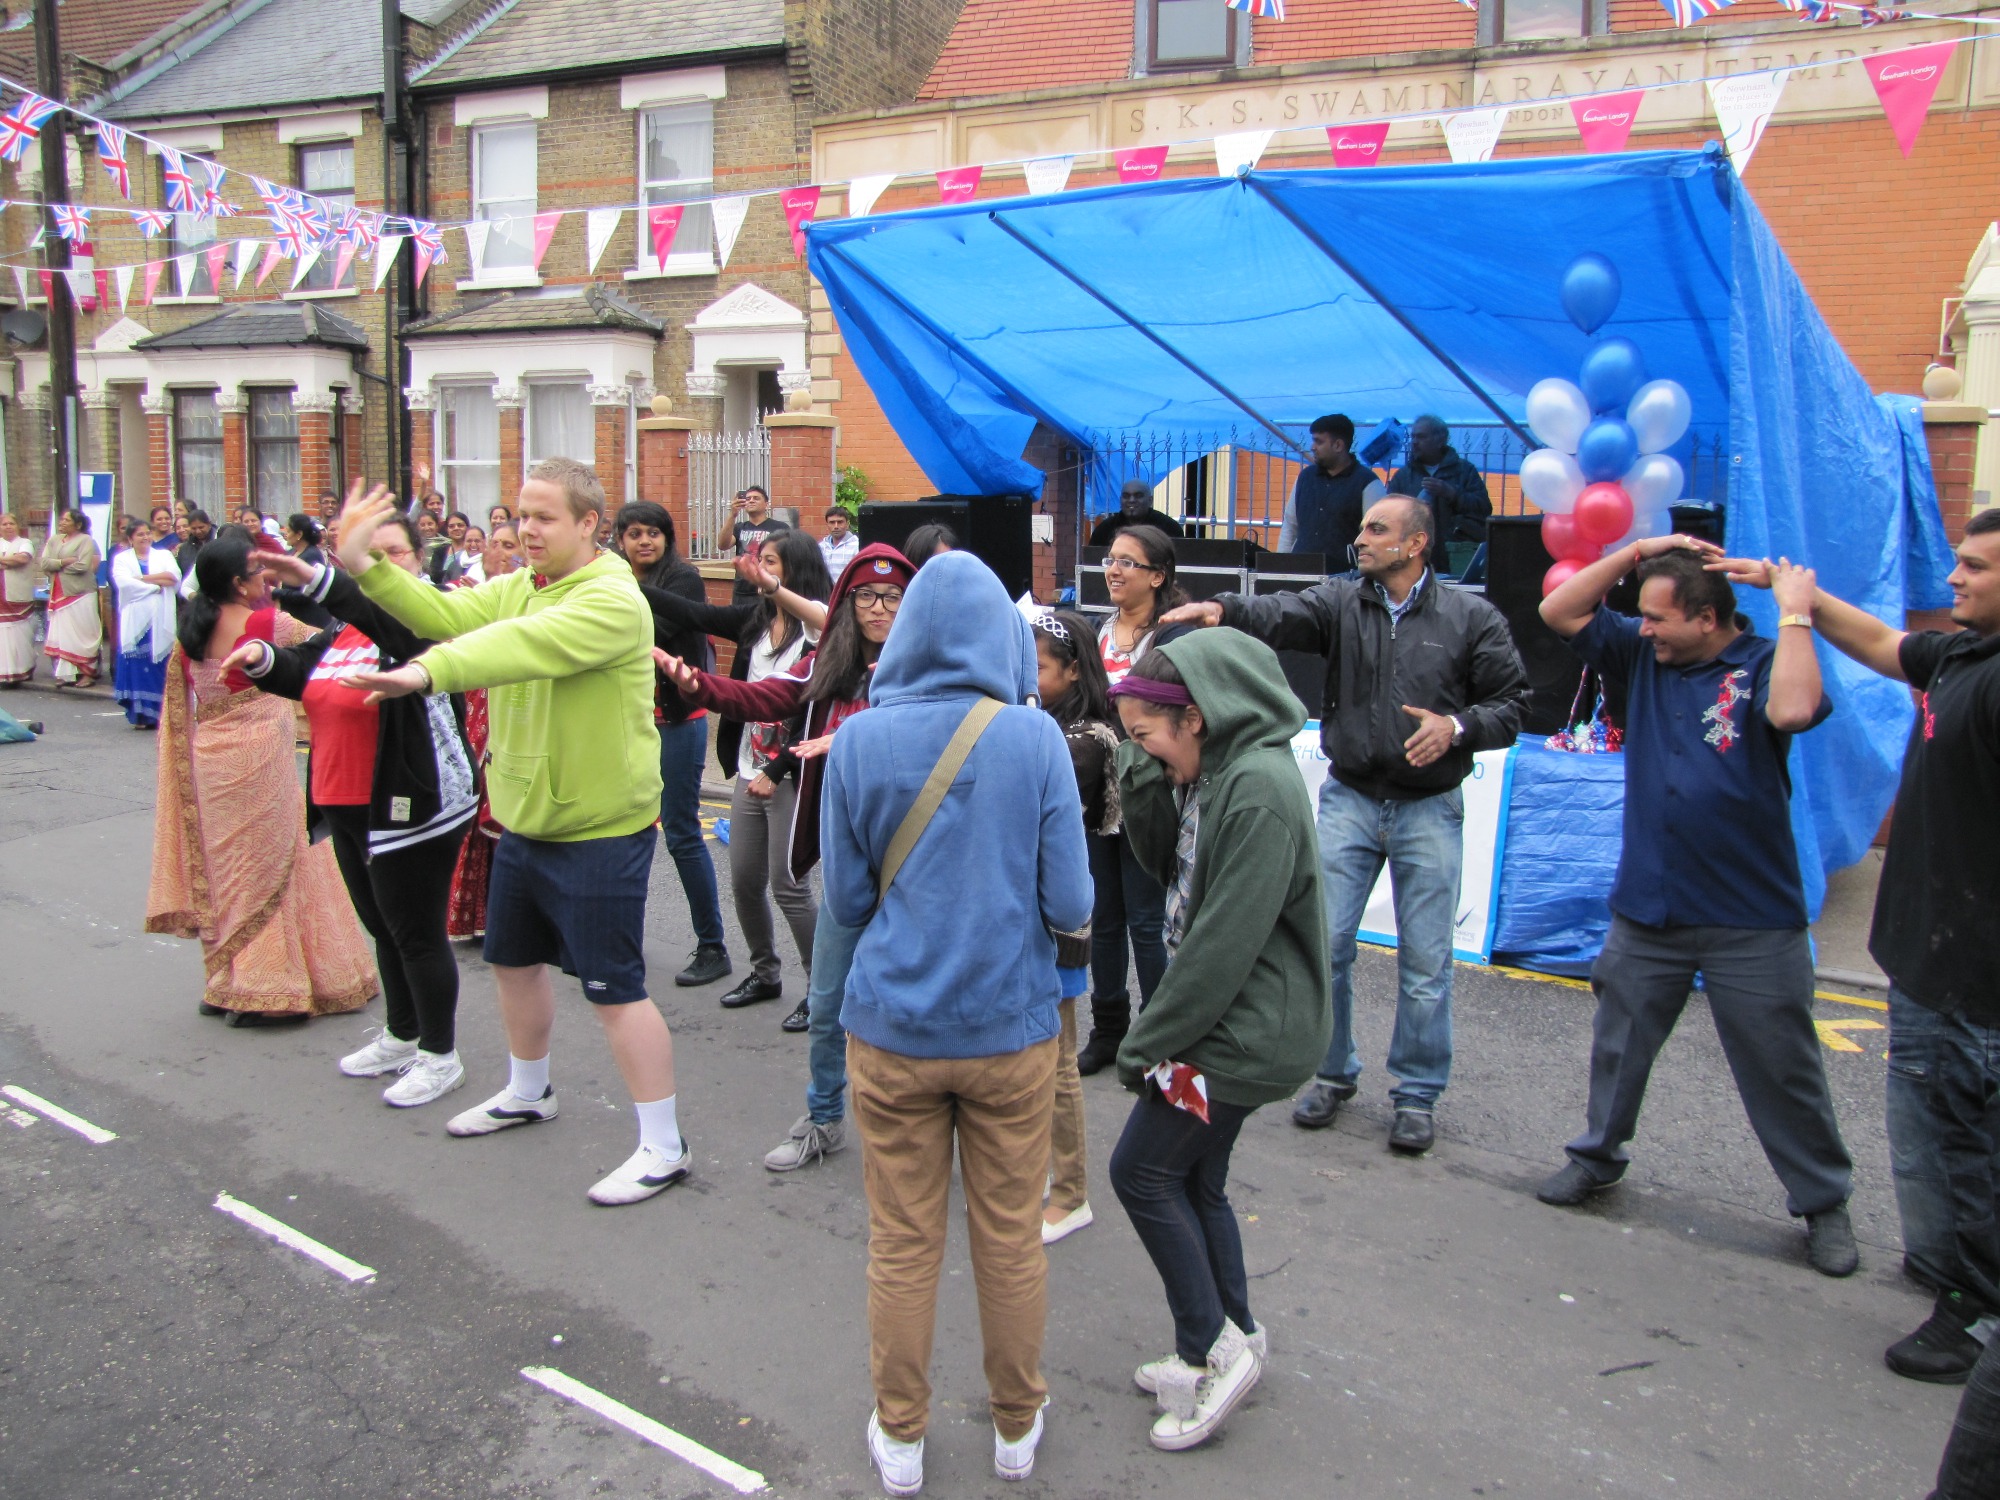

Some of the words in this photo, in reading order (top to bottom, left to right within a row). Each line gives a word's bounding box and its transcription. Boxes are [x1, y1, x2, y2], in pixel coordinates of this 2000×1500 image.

[1880, 70, 1909, 81] Newham
[1910, 65, 1937, 76] London
[1283, 63, 1684, 121] SWAMINARAYAN
[1726, 84, 1767, 93] Newham
[1608, 112, 1629, 120] London
[1337, 142, 1358, 150] Newham
